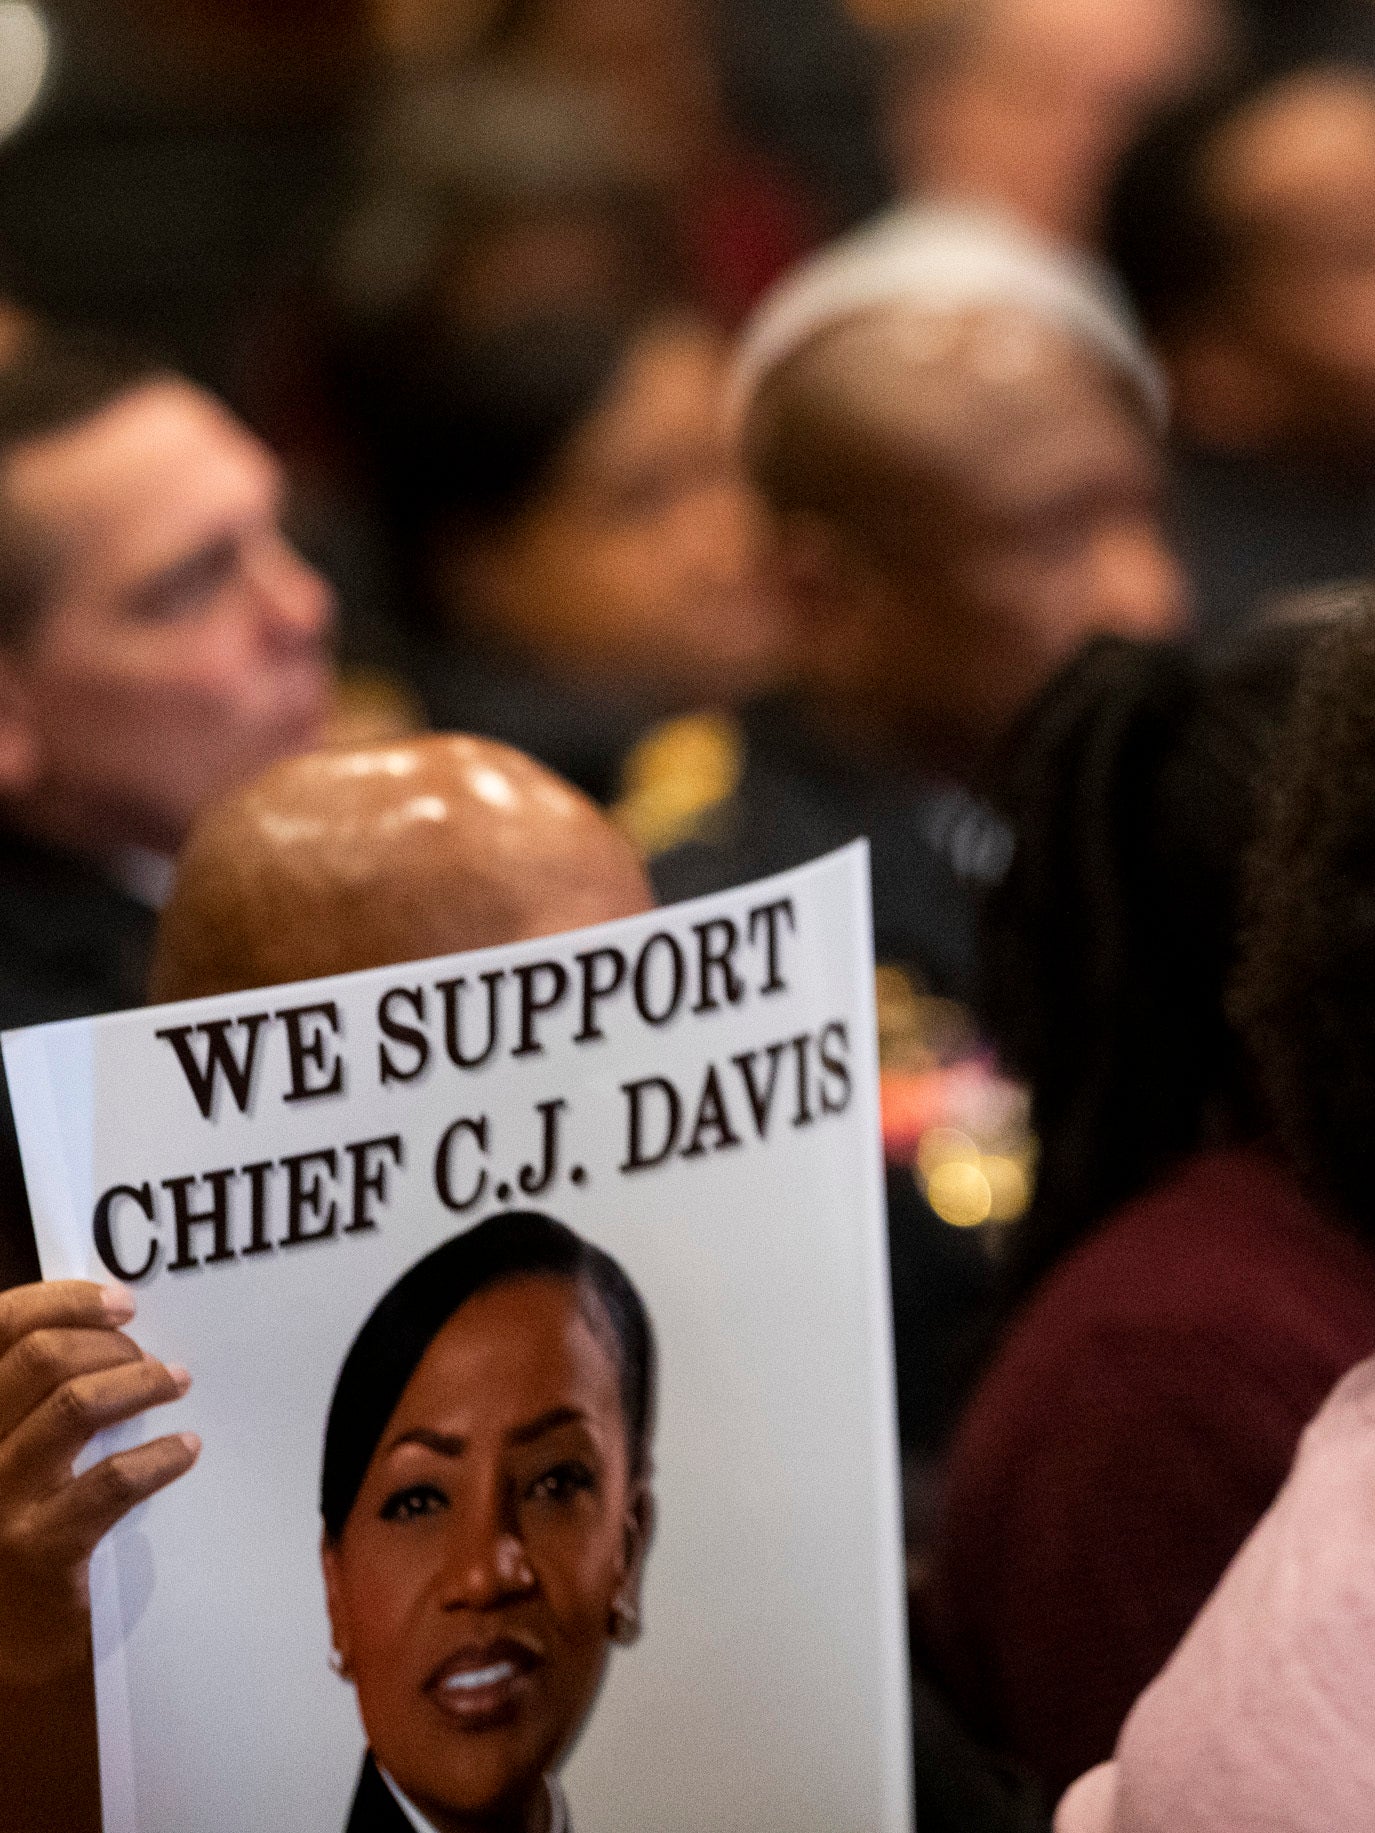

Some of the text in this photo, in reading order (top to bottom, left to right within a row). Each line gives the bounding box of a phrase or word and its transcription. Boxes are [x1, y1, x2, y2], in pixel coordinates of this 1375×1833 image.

[156, 897, 799, 1121] WE SUPPORT
[93, 1020, 854, 1284] CHIEF C.J. DAVIS
